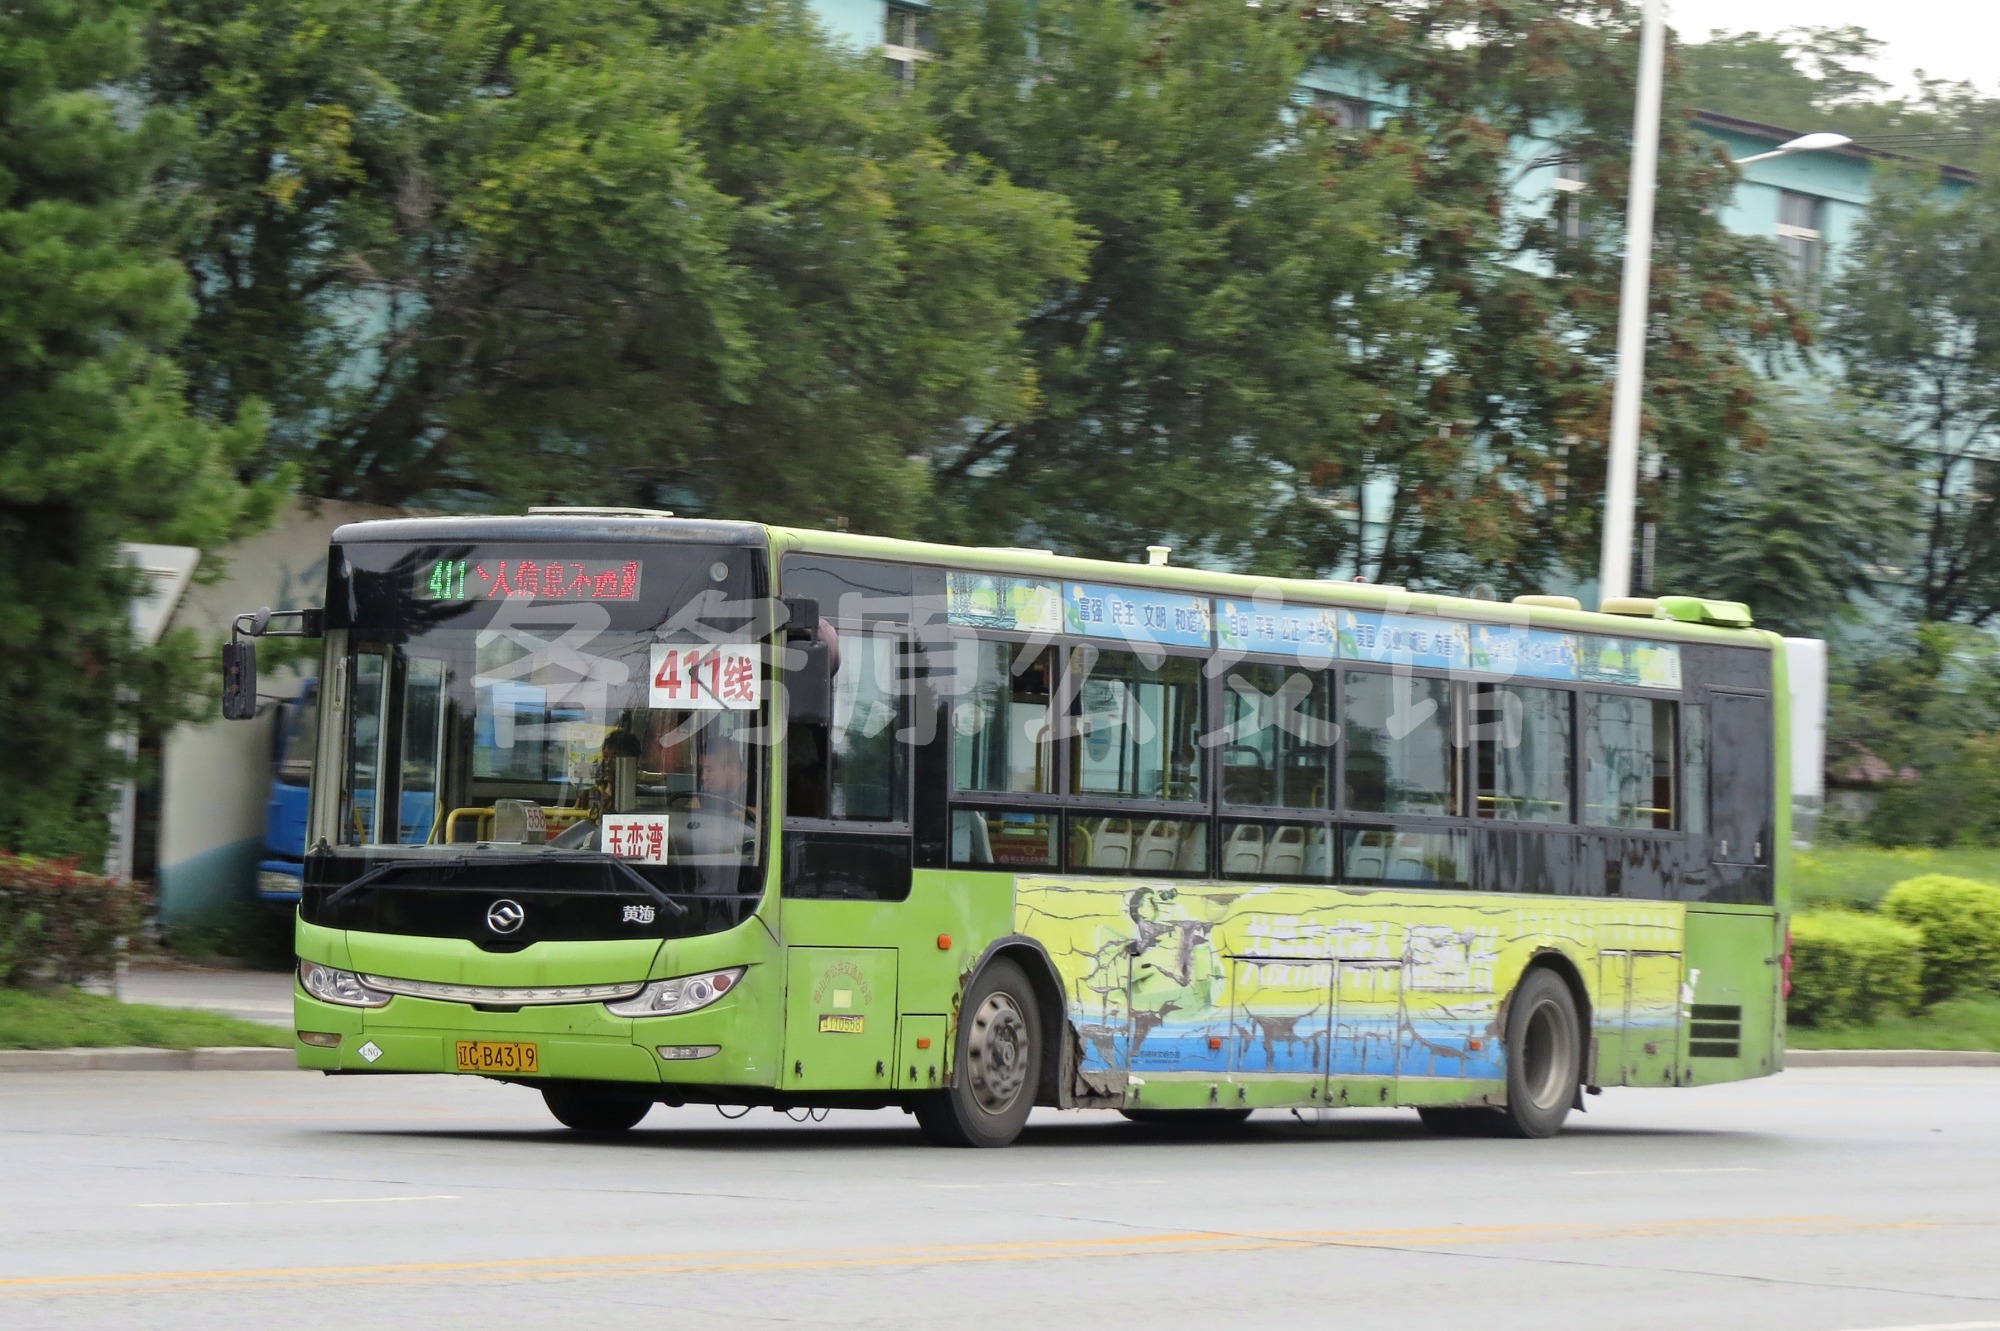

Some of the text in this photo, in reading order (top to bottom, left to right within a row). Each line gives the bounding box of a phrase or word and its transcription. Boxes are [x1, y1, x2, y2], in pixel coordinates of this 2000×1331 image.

[430, 561, 466, 599] 411
[1079, 597, 1104, 624] 富强
[1112, 601, 1135, 626] 民主
[1144, 604, 1167, 630] 文明
[1175, 608, 1199, 634] 和谐
[1230, 614, 1249, 638] 自由
[655, 650, 754, 702] 411线
[528, 809, 546, 829] 558
[623, 905, 656, 924] 黄海
[362, 1046, 380, 1058] LNG
